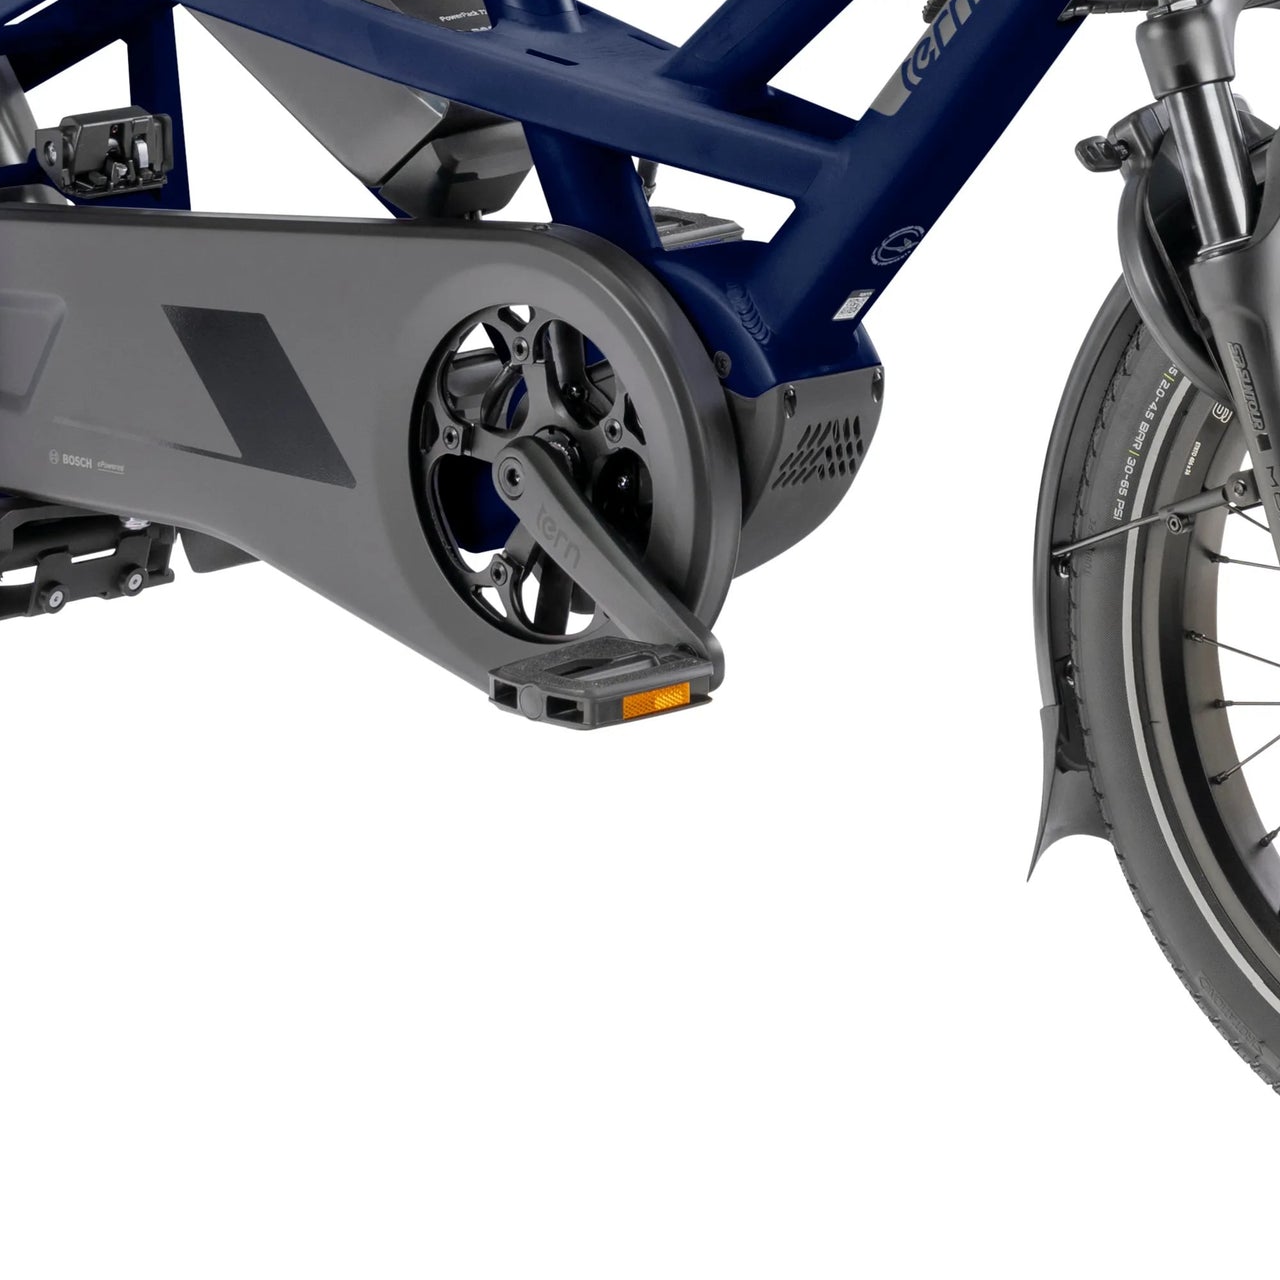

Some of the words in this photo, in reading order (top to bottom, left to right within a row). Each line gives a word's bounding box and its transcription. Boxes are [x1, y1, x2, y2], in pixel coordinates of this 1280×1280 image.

[1133, 421, 1150, 451] BAR
[63, 453, 93, 469] BOSCH
[1118, 456, 1137, 497] 30-65
[1113, 498, 1125, 520] PSI
[536, 500, 581, 570] tern
